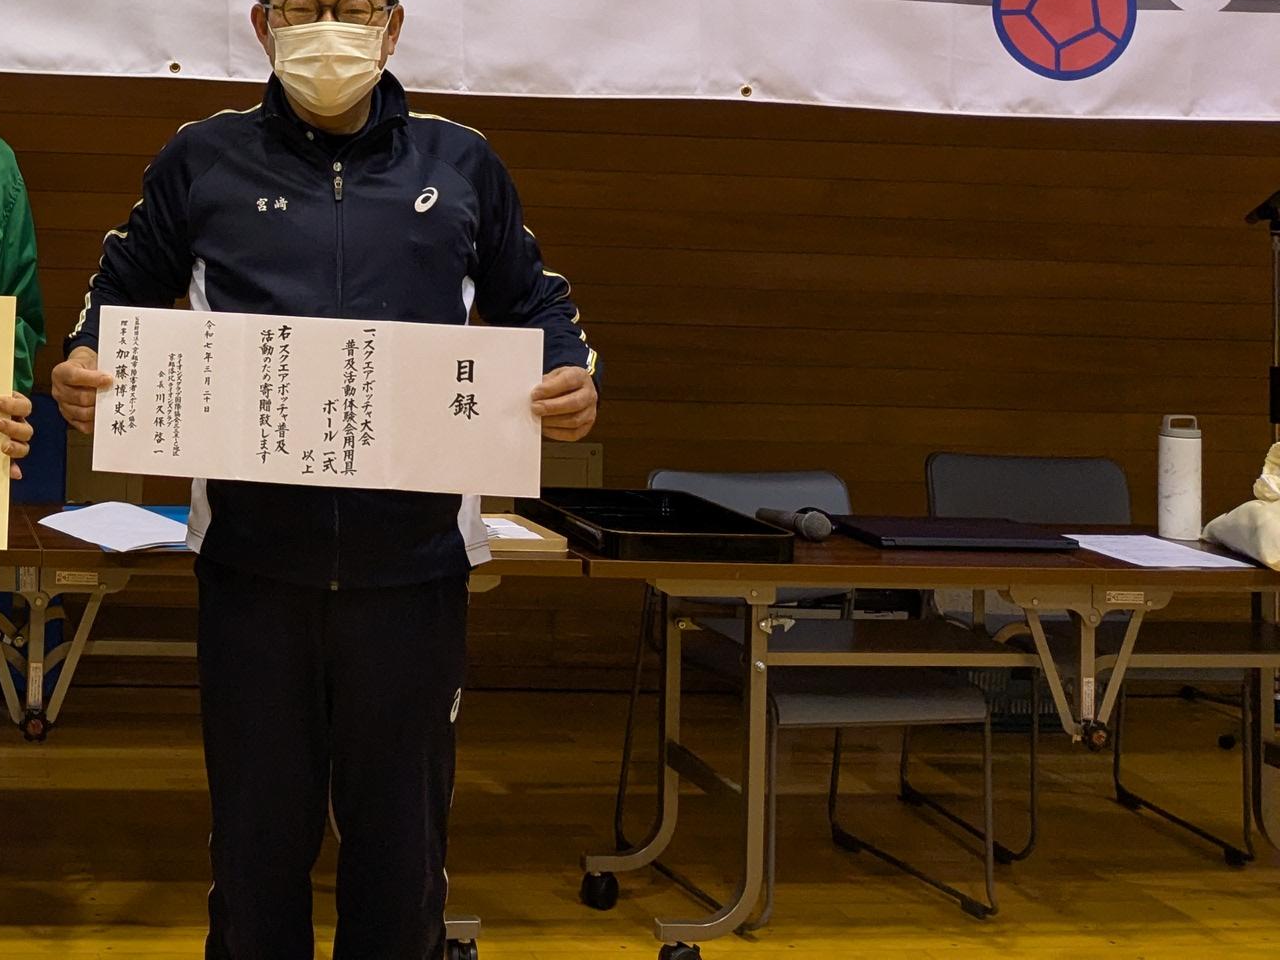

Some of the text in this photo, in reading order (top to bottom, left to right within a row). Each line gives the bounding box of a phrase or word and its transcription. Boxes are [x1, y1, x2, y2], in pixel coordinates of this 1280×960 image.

[256, 329, 275, 464] 活動のため寄贈致します
[448, 358, 480, 420] 目録
